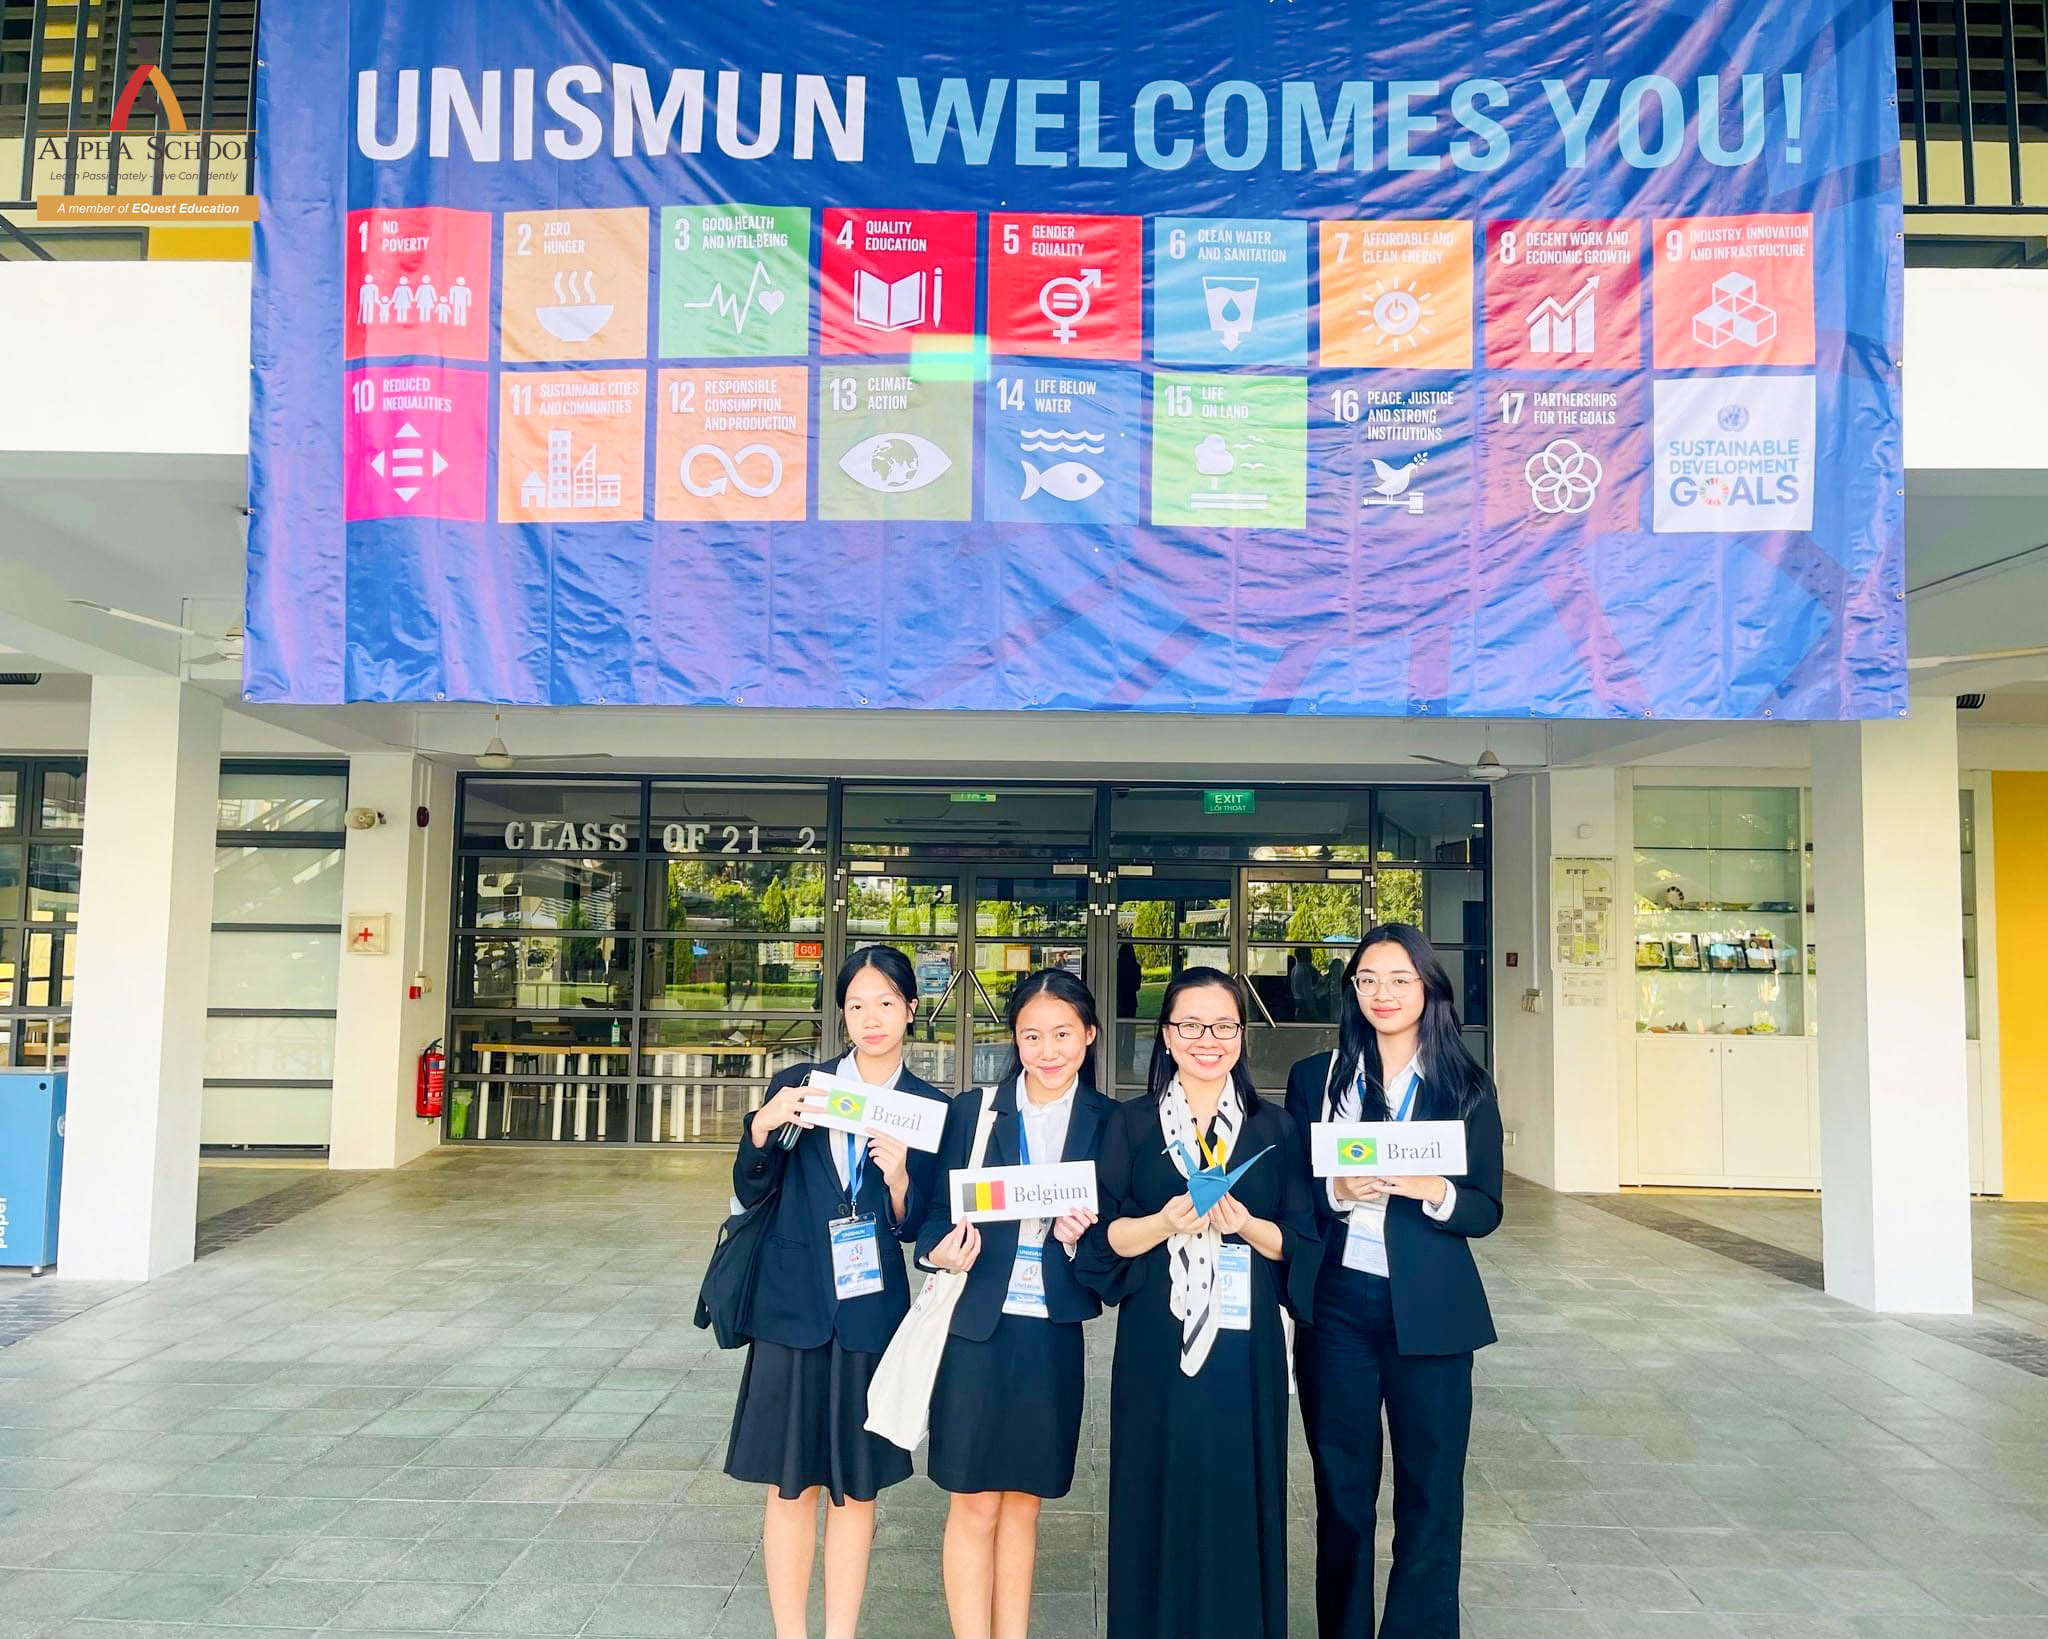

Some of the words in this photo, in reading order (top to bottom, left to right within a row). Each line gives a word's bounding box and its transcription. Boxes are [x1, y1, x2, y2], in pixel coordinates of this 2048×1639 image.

[357, 63, 866, 162] UNISMUN
[896, 77, 1511, 173] WELCOMES
[1539, 72, 1803, 170] YOU!
[383, 220, 399, 234] NO
[543, 222, 571, 237] ZERO
[702, 217, 733, 232] GOOD
[735, 216, 775, 231] HEALTH
[864, 220, 912, 235] QUALITY
[1031, 223, 1076, 240] GENDER
[1746, 225, 1809, 240] INNOVATION
[359, 220, 369, 253] 1
[517, 223, 533, 257] 2
[674, 218, 691, 251] 3
[702, 234, 725, 250] AND
[726, 233, 789, 249] WELL-BEING
[836, 220, 855, 250] 4
[1003, 223, 1020, 255] 5
[1197, 228, 1233, 244] CLEAN
[1235, 229, 1272, 245] WATER
[1363, 231, 1429, 246] AFFORDABLE
[1430, 231, 1456, 246] AND
[1525, 231, 1567, 247] DECENT
[1569, 231, 1602, 246] WORK
[1605, 231, 1629, 246] AND
[382, 237, 430, 251] POVERTY
[543, 239, 586, 254] HUNGER
[864, 237, 927, 252] EDUCATION
[1031, 241, 1085, 257] EQUALITY
[1169, 228, 1187, 260] 6
[1334, 231, 1350, 265] 7
[1499, 230, 1517, 265] 8
[1666, 228, 1684, 263] 9
[1689, 246, 1715, 261] AND
[1714, 243, 1806, 260] INFRASTRUCTURE
[1197, 246, 1223, 262] AND
[1224, 246, 1287, 263] SANITATION
[1362, 249, 1398, 265] CLEAN
[1401, 249, 1444, 265] ENERGY
[1525, 248, 1582, 265] ECONOMIC
[1584, 248, 1631, 265] GROWTH
[383, 378, 431, 393] REDUCED
[540, 382, 606, 397] SUSTAINABLE
[608, 380, 640, 396] CITIES
[704, 380, 777, 395] RESPONSIBLE
[867, 376, 914, 392] CLIMATE
[1034, 378, 1057, 395] LIFE
[1058, 379, 1097, 395] BELOW
[352, 379, 375, 414] 10
[511, 383, 533, 417] 11
[669, 380, 696, 413] 12
[829, 377, 858, 412] 13
[996, 377, 1026, 412] 14
[1164, 384, 1193, 417] 15
[1201, 386, 1225, 401] LIFE
[1366, 390, 1406, 407] PEACE,
[1408, 390, 1454, 406] JUSTICE
[1533, 391, 1618, 408] PARTNERSHIPS
[382, 396, 452, 412] INEQUALITIES
[540, 400, 561, 416] AND
[562, 399, 633, 416] COMMUNITIES
[704, 397, 782, 413] CONSUMPTION
[867, 395, 908, 410] ACTION
[1034, 398, 1072, 414] WATER
[1201, 403, 1218, 418] ON
[1219, 403, 1249, 419] LAND
[1331, 389, 1360, 423] 16
[1499, 391, 1525, 425] 17
[704, 415, 727, 431] AND
[728, 415, 797, 431] PRODUCTION
[1367, 408, 1392, 423] AND
[1393, 408, 1437, 424] STRONG
[1533, 410, 1555, 425] FOR
[1557, 410, 1577, 425] THE
[1579, 410, 1617, 425] GOALS
[1367, 426, 1443, 442] INSTITUTIONS
[1669, 439, 1801, 457] SUSTAINABLE
[1669, 458, 1800, 475] DEVELOPMENT
[1669, 475, 1800, 508] GOALS
[1215, 794, 1244, 804] EXIT
[504, 820, 628, 852] CLASS
[662, 823, 711, 853] OF
[720, 825, 763, 854] 21
[797, 827, 817, 854] 2
[800, 945, 817, 955] G01
[872, 1104, 923, 1130] Brazil
[1386, 1141, 1441, 1160] Brazil
[1013, 1183, 1089, 1206] Belgium
